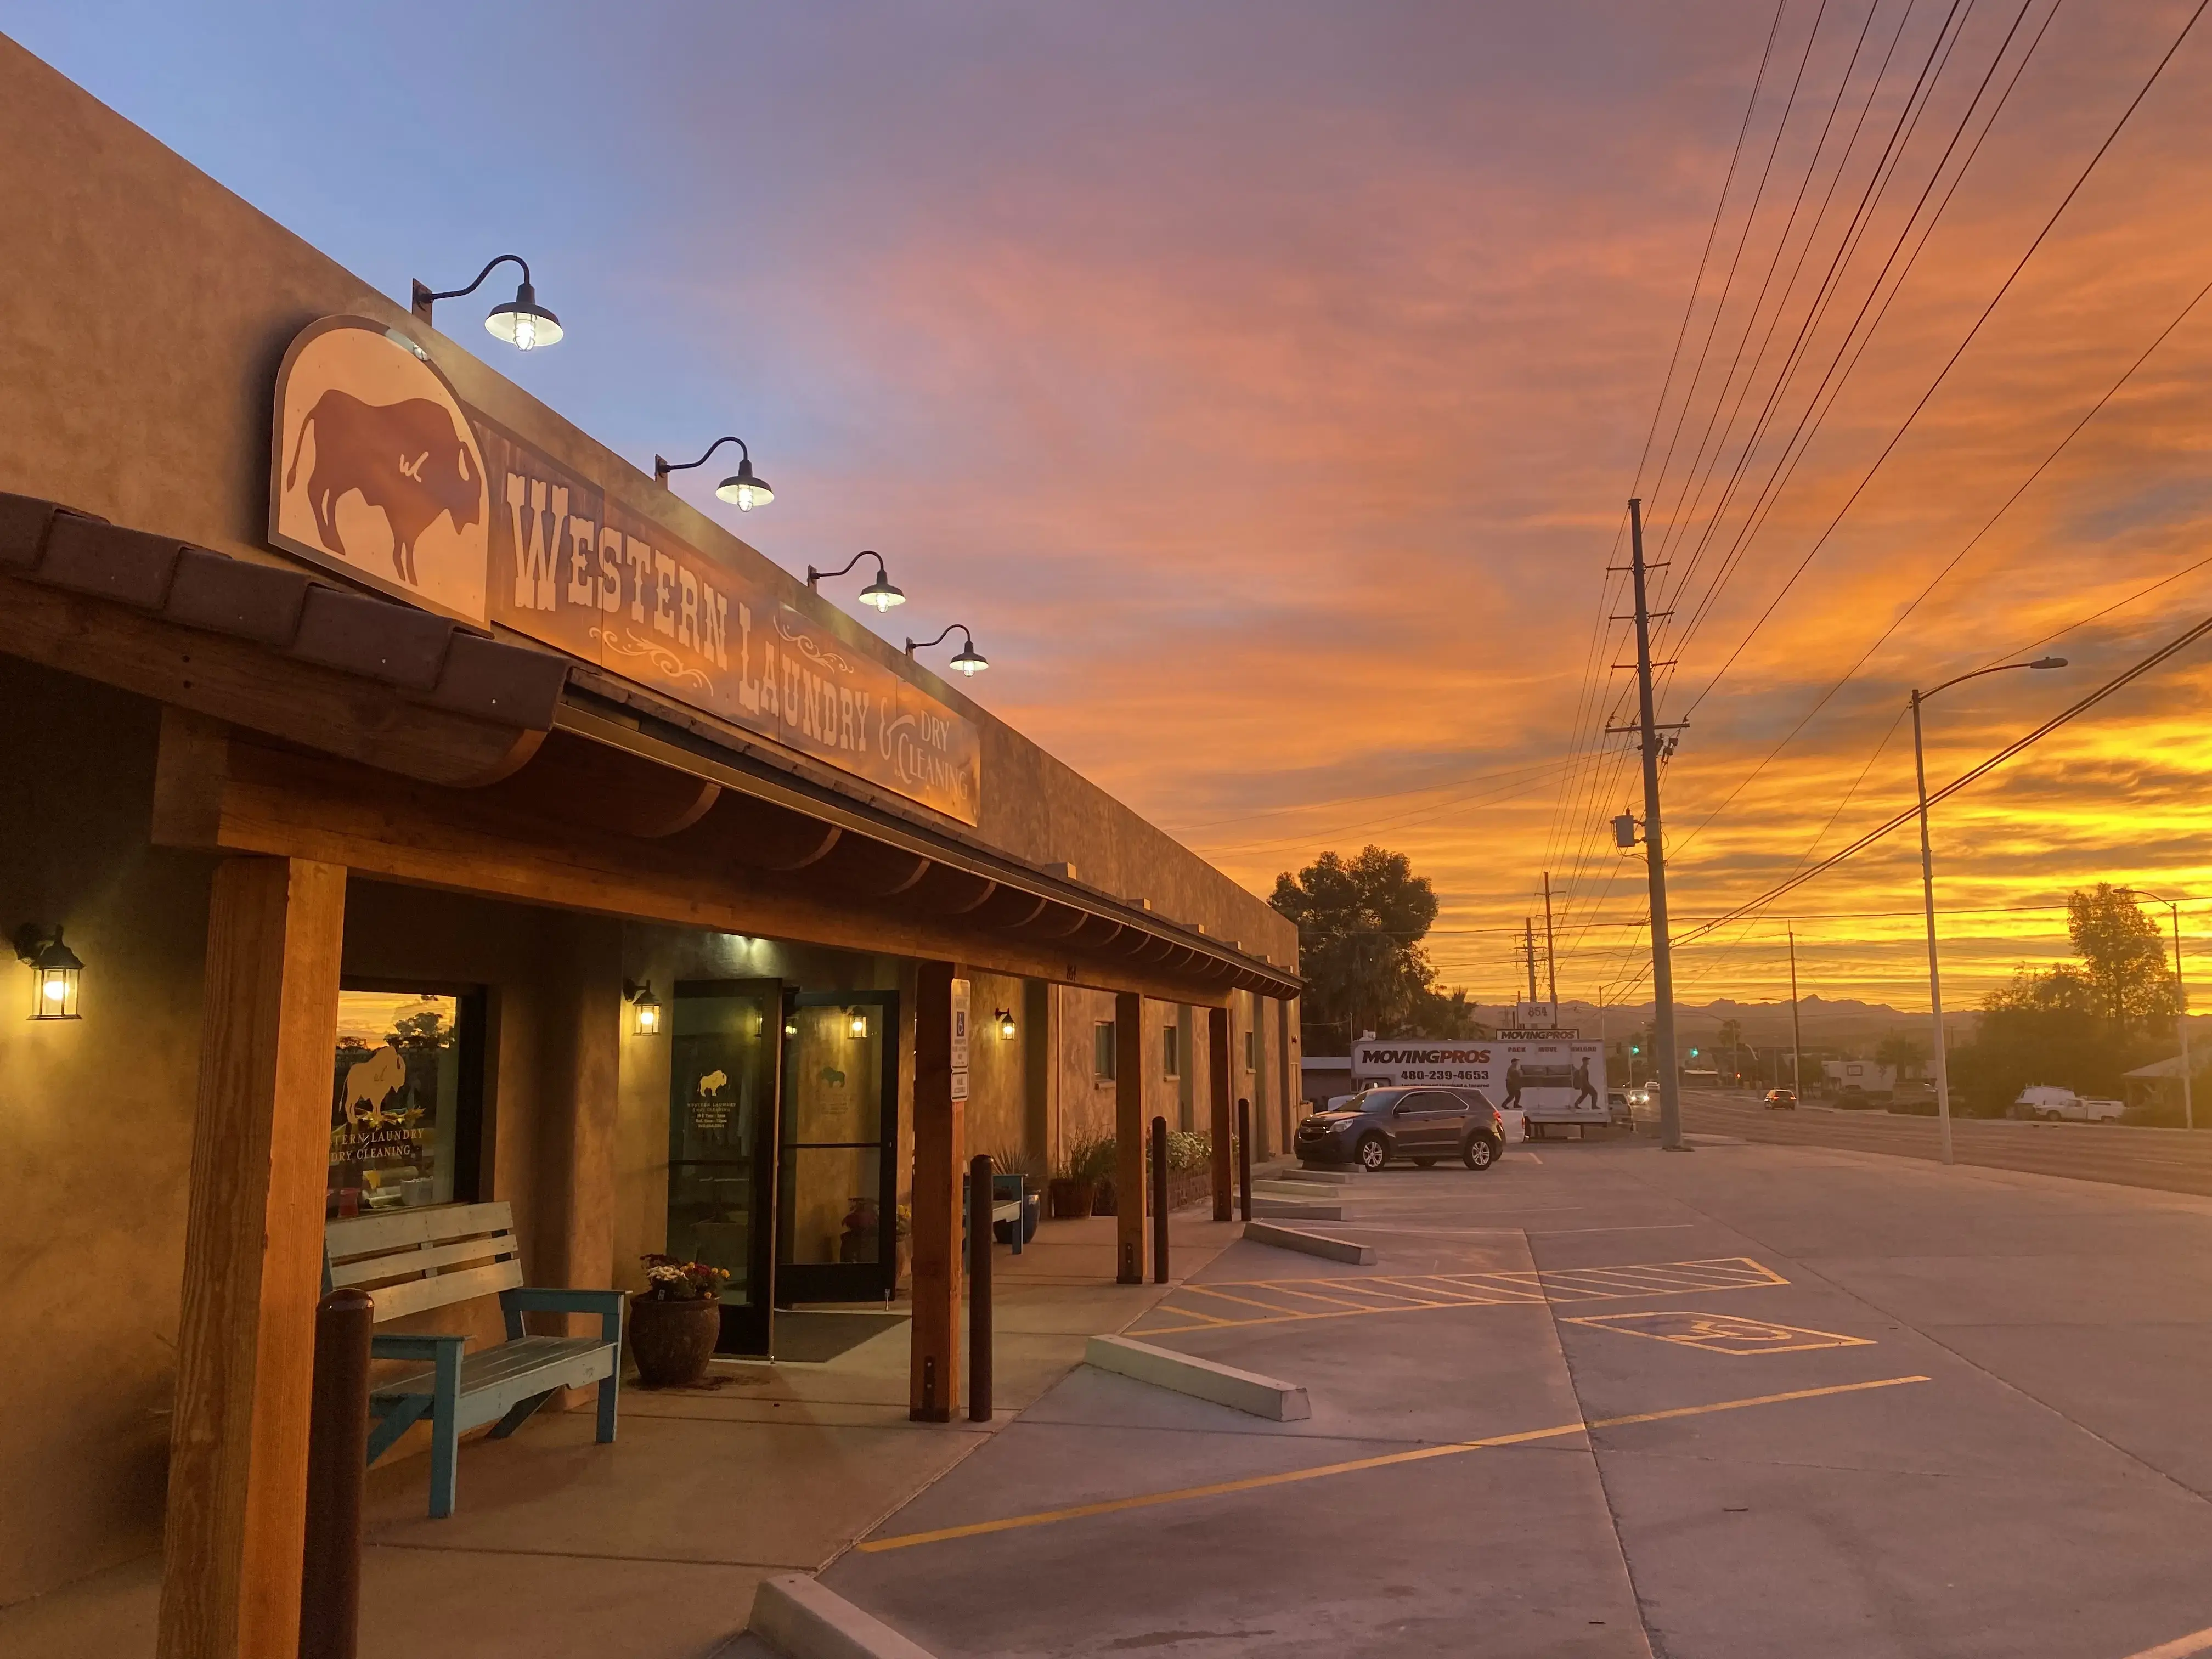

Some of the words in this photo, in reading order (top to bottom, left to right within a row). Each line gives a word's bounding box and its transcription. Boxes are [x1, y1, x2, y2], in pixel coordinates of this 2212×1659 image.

[507, 473, 727, 671] WESTERN
[739, 602, 869, 752] LAUNDRY
[879, 697, 916, 760] &
[921, 710, 949, 752] DRY
[898, 733, 968, 799] CLEANING
[1528, 1007, 1548, 1017] 854
[1362, 1050, 1491, 1064] MOVINGPROS
[1401, 1070, 1489, 1080] 480-239-4653
[371, 1128, 424, 1142] LAUNDRY
[331, 1150, 352, 1162] DRY
[357, 1145, 410, 1159] CLEANING
